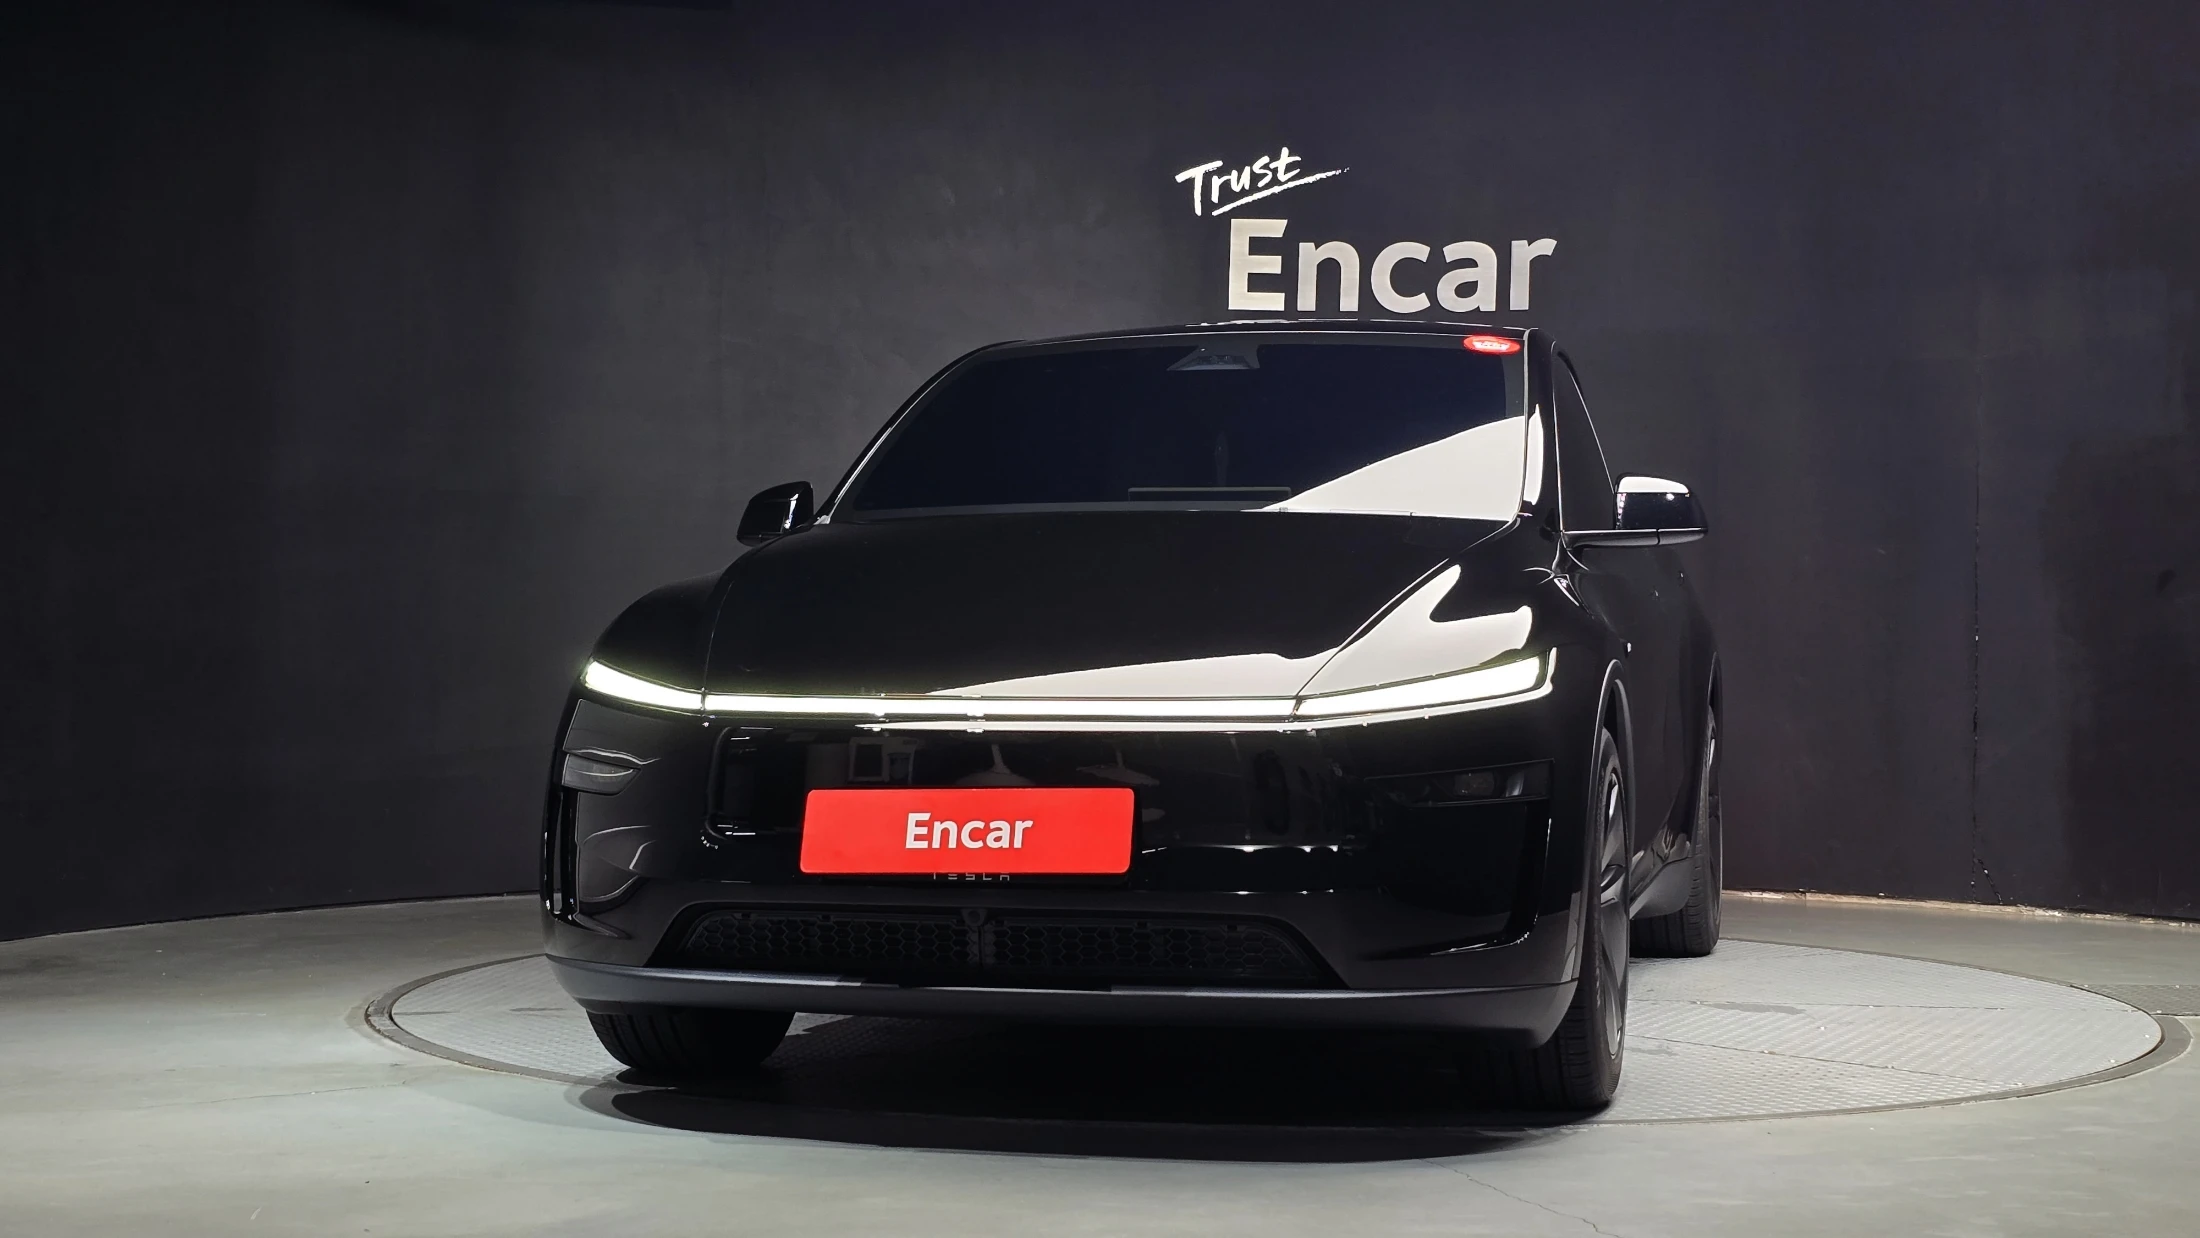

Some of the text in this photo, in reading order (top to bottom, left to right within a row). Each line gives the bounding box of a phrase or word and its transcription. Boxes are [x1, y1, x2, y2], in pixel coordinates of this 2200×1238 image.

[1175, 146, 1302, 216] Trust
[1227, 218, 1558, 314] Encar
[904, 812, 1034, 850] Encar
